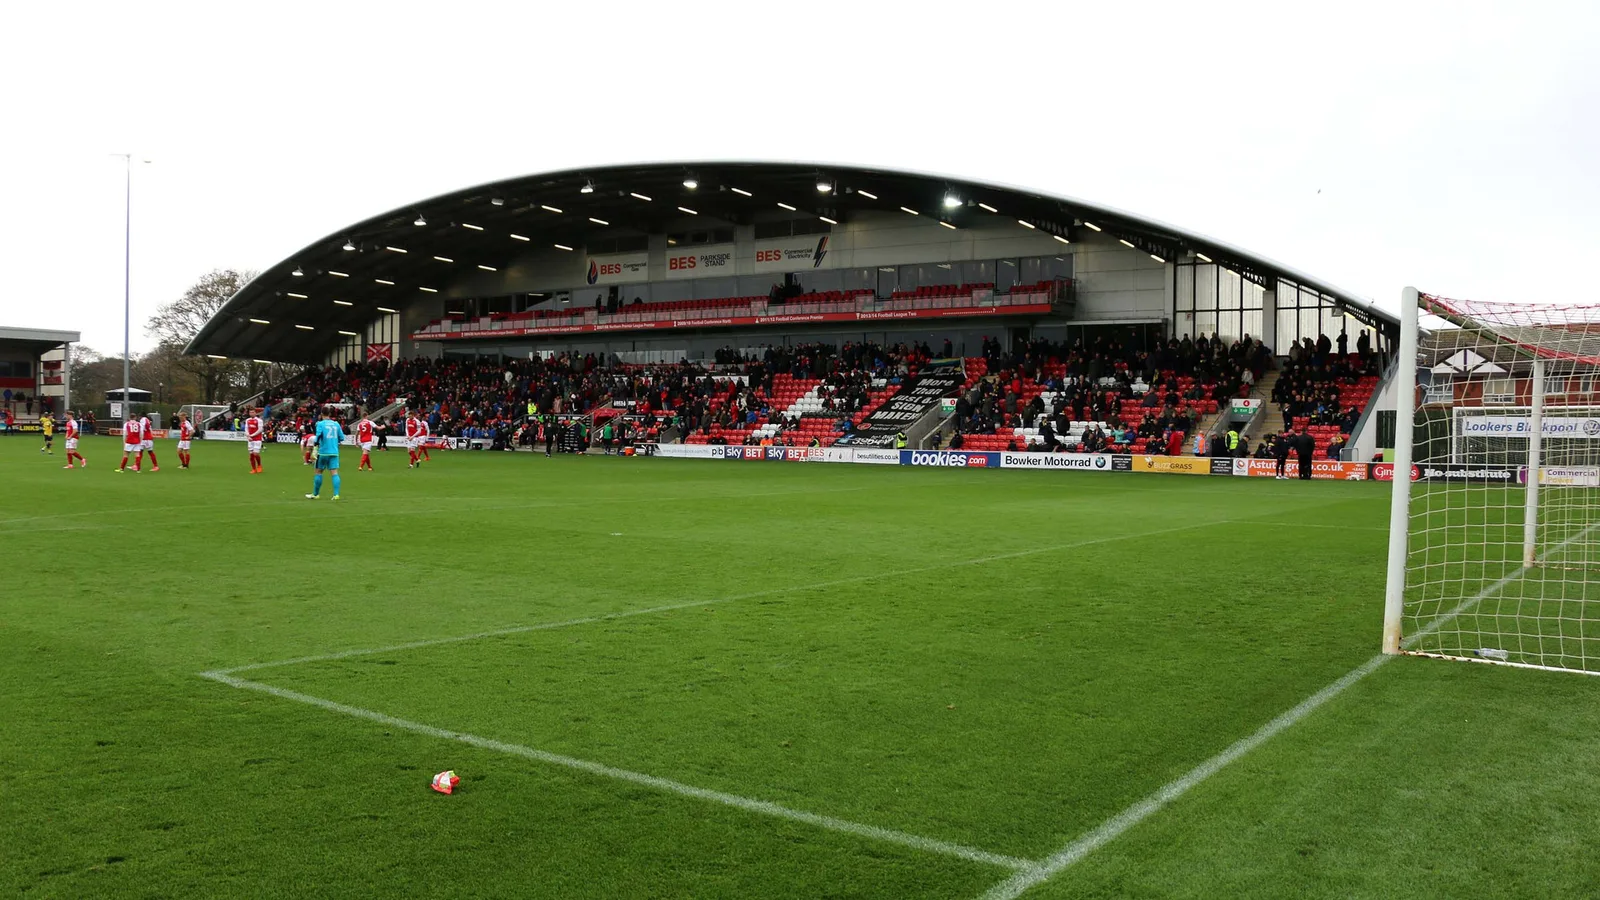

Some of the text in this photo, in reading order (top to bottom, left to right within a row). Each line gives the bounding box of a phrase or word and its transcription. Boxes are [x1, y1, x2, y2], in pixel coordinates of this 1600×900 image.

[700, 253, 731, 262] PARKSIDE
[756, 250, 782, 262] BES
[669, 256, 697, 270] BES
[600, 263, 621, 275] BES
[917, 378, 954, 387] More
[911, 387, 943, 395] Than
[891, 401, 926, 412] SIGN
[870, 411, 922, 420] MAKER
[129, 423, 139, 432] 18
[325, 425, 338, 439] 21
[1465, 422, 1578, 434] Lookers Blkpool
[726, 446, 762, 458] sky BET
[768, 449, 805, 461] sky BET
[808, 449, 825, 457] BES
[1005, 455, 1091, 467] Bowker Motorrad
[1547, 469, 1598, 477] Commercial
